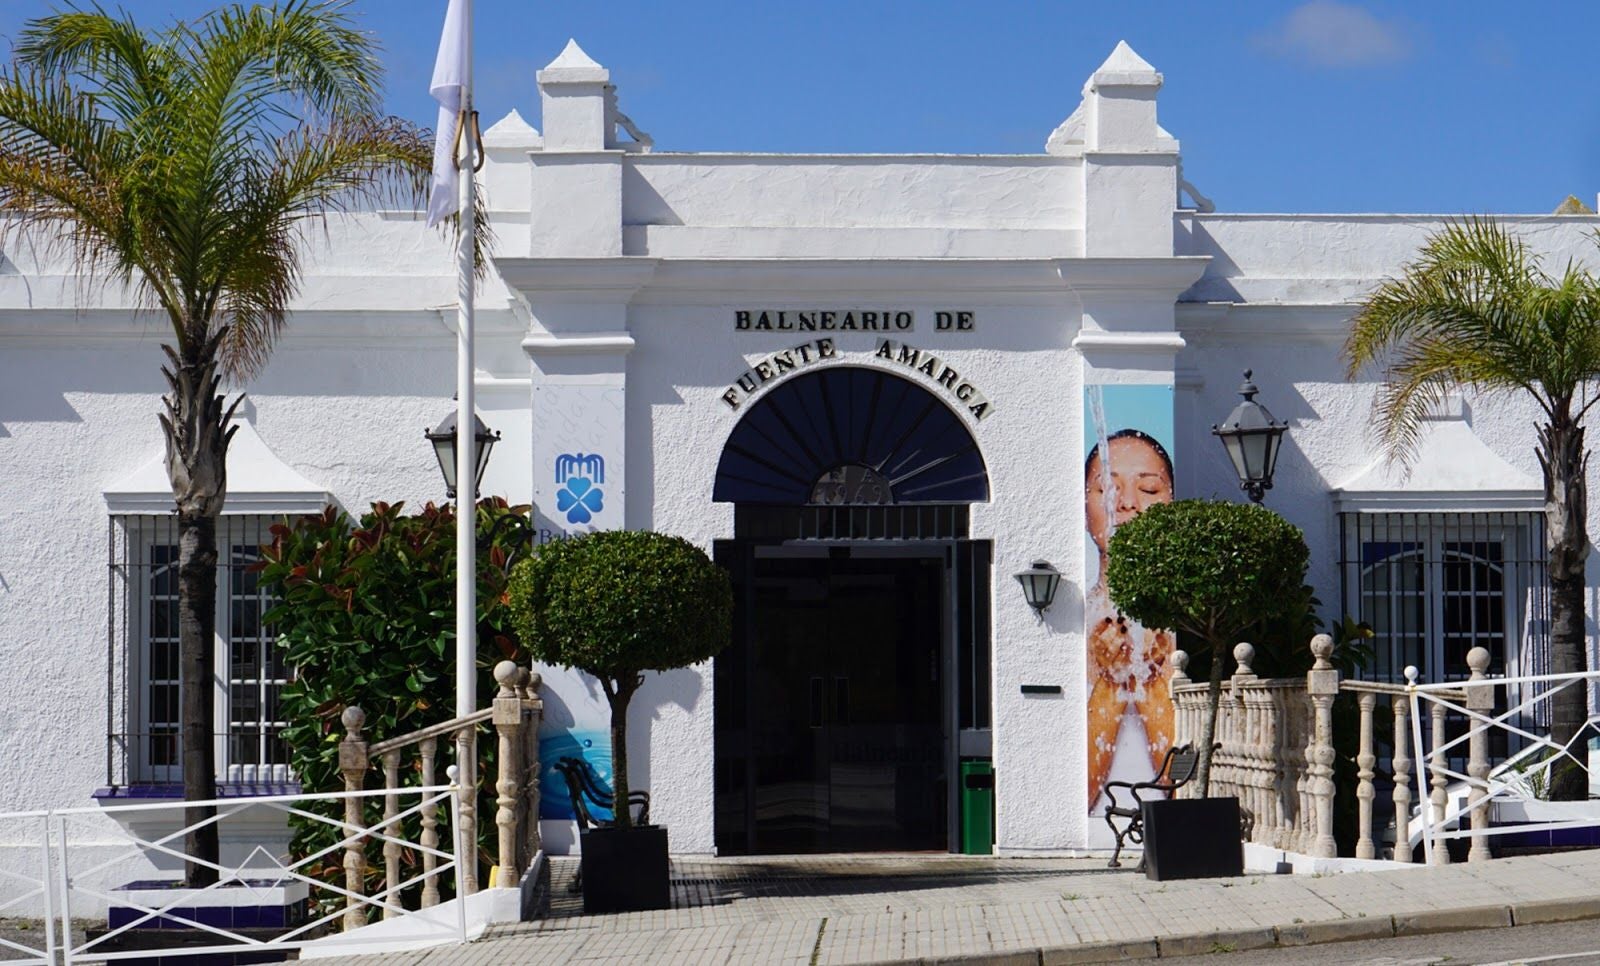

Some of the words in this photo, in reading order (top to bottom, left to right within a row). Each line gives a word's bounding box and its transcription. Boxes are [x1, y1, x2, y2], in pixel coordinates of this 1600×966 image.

[735, 311, 912, 331] BALNEARIO
[936, 311, 974, 330] DE
[722, 338, 836, 409] FUENTE
[875, 339, 992, 421] AMARGA
